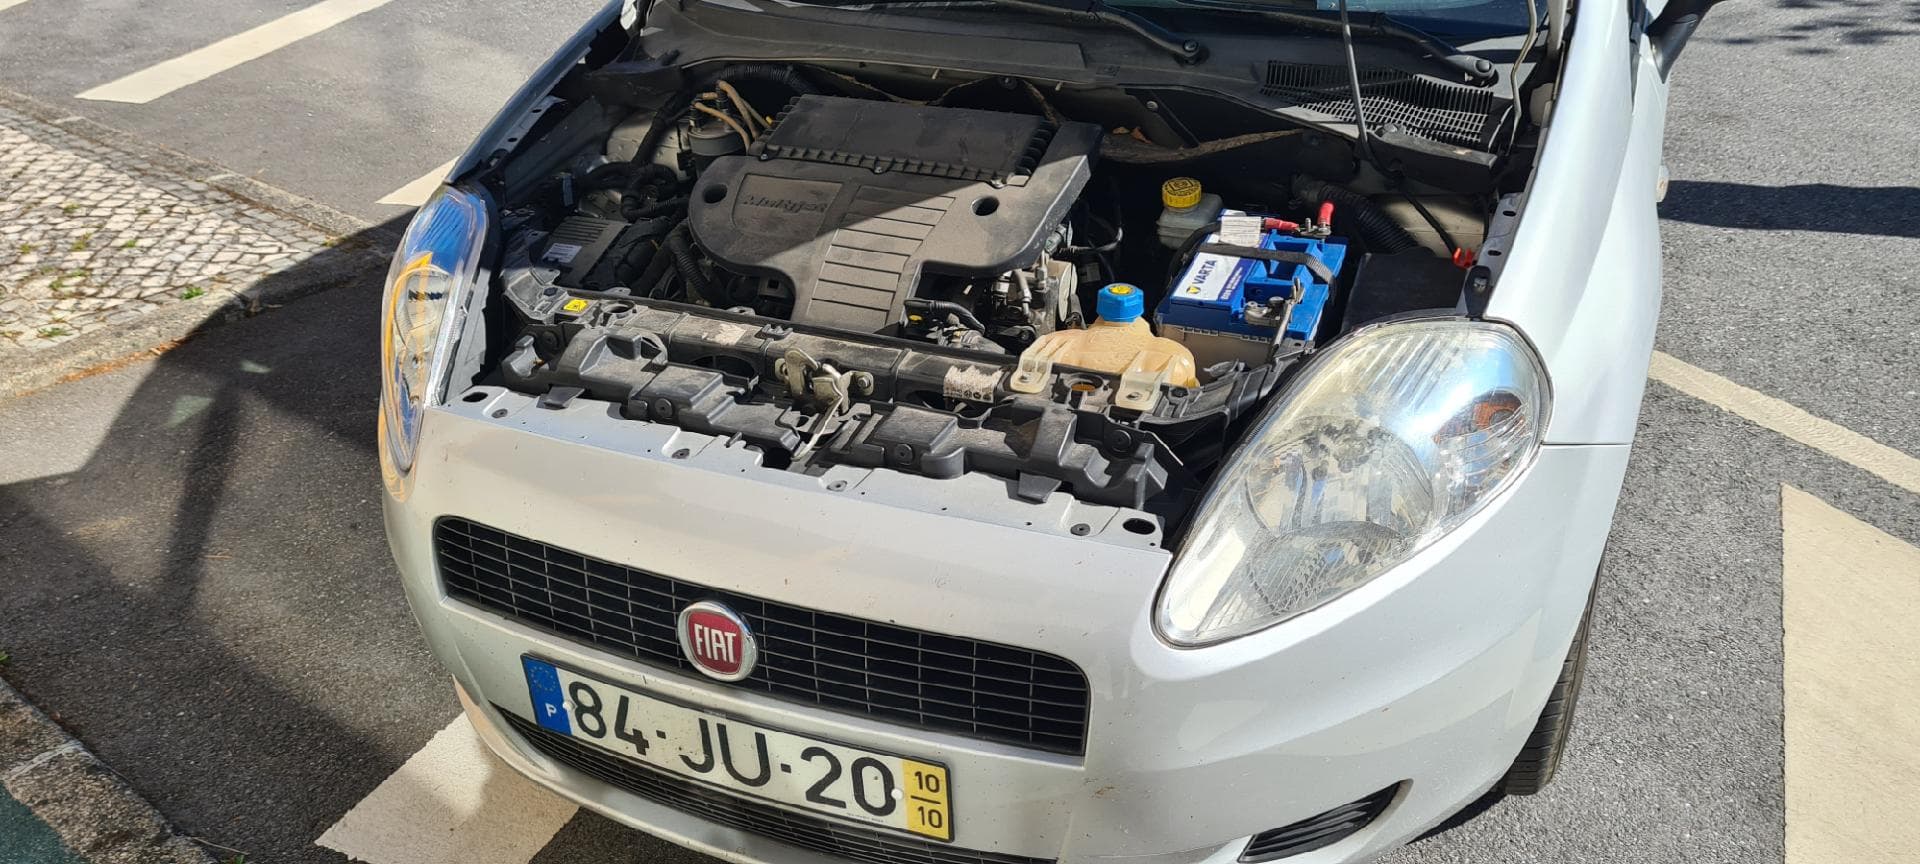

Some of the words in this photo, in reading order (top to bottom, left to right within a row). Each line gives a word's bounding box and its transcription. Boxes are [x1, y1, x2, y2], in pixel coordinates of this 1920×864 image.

[1192, 260, 1217, 284] VARTA
[694, 623, 737, 664] FIAT
[545, 702, 557, 717] P
[914, 770, 940, 794] 10
[917, 805, 943, 829] 10
